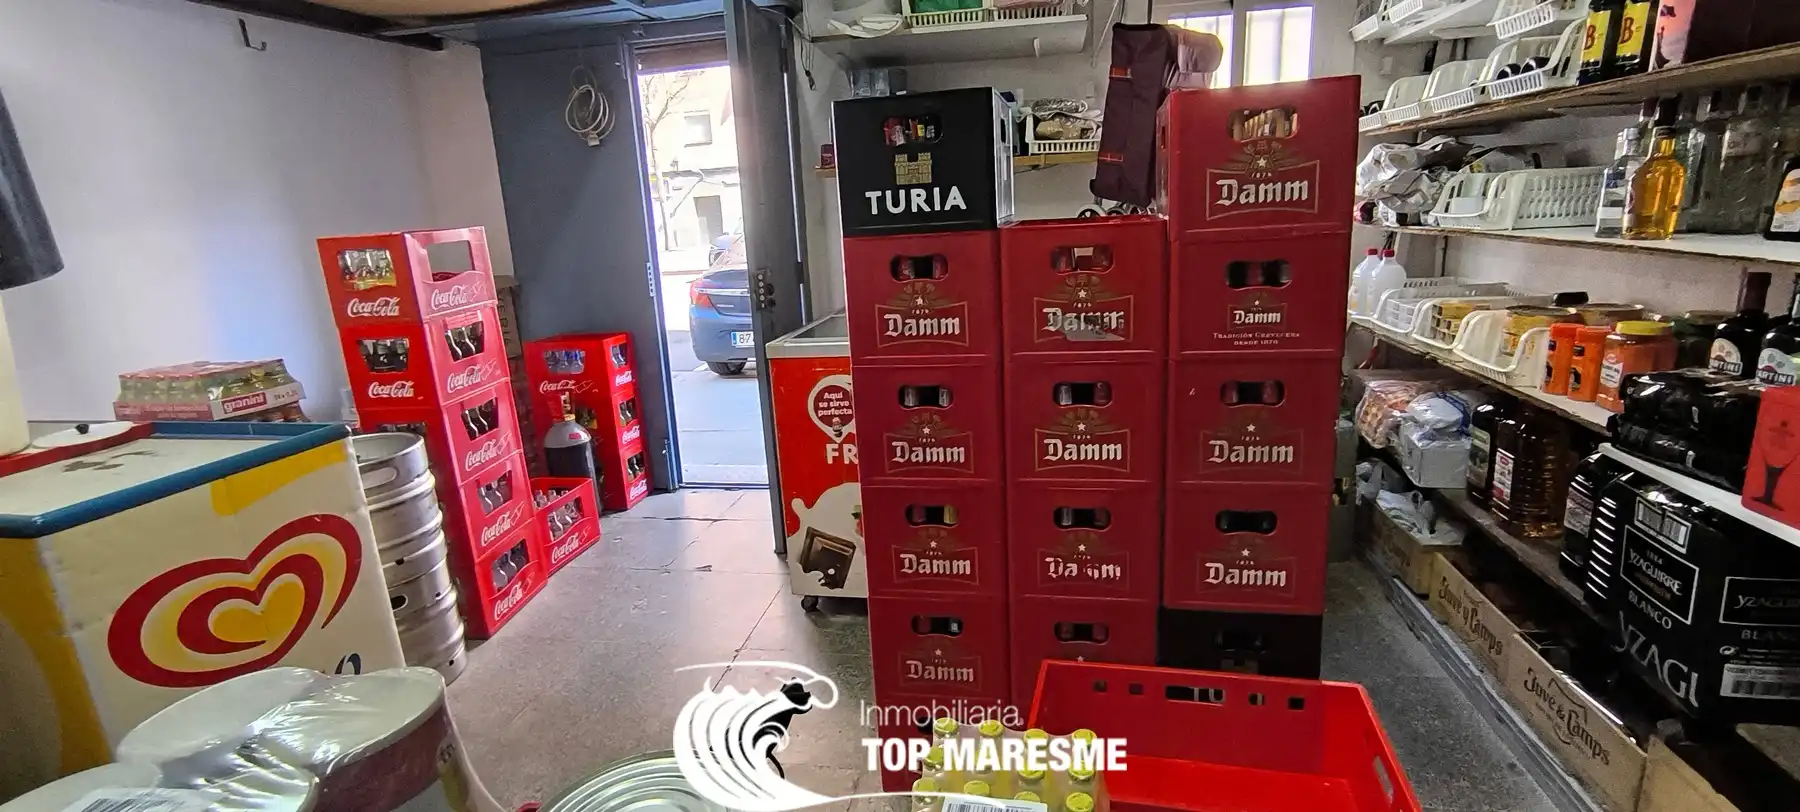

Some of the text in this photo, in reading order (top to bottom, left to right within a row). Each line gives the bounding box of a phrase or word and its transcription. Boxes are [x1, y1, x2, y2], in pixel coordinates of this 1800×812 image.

[865, 186, 966, 215] TURIA
[1215, 179, 1308, 206] Damm
[884, 313, 960, 337] Damm
[1232, 310, 1281, 324] Damm
[223, 394, 264, 412] granini
[891, 441, 965, 463] Damm
[1043, 439, 1122, 461] Damm
[1206, 440, 1294, 463] Damm
[900, 554, 971, 575] Damm
[1202, 562, 1287, 587] Damm
[1628, 548, 1683, 595] YZAGUIRRE
[1628, 590, 1672, 630] BLANCO
[905, 660, 974, 682] Damm
[1567, 709, 1610, 766] Camps
